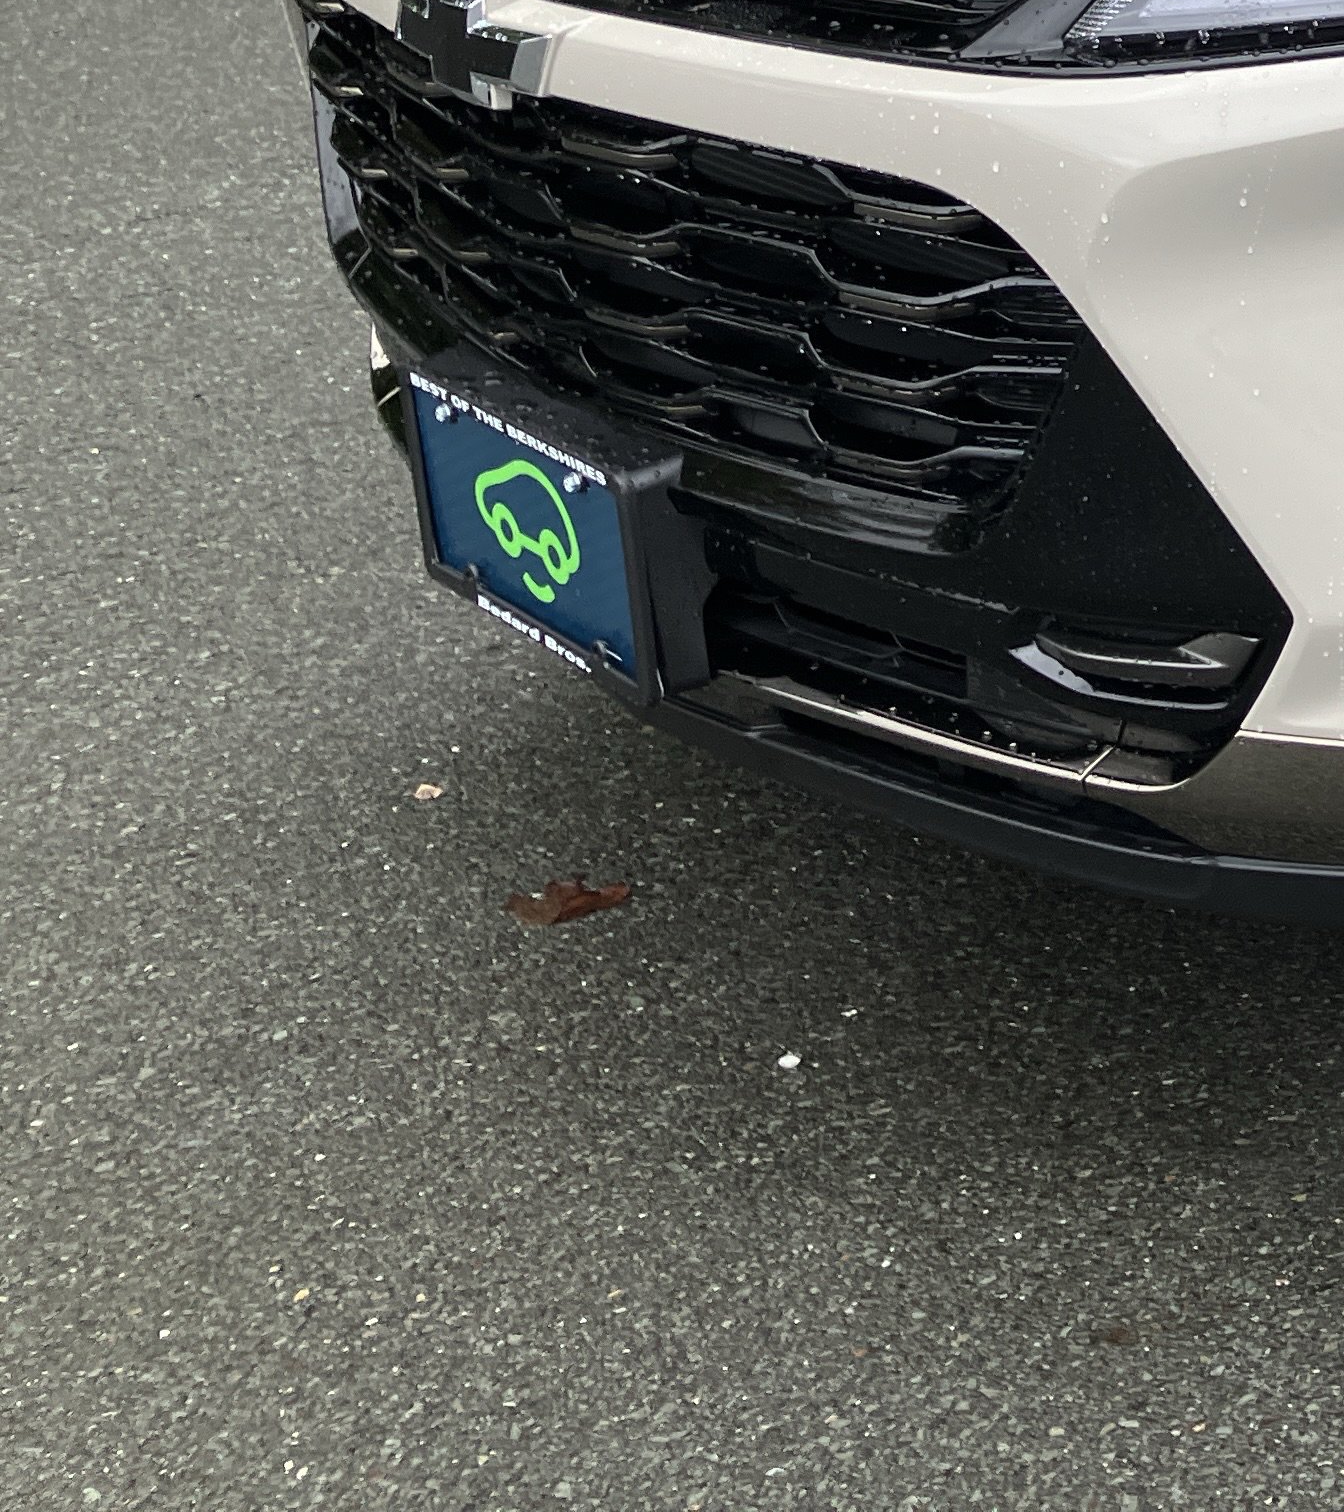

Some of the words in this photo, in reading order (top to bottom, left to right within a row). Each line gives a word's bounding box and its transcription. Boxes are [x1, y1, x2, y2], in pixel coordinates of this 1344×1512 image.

[409, 372, 448, 401] BEST
[450, 394, 470, 413] OF
[471, 405, 505, 433] THE
[505, 423, 607, 486] BERKSHIRES
[477, 594, 541, 642] Bedard
[544, 634, 592, 673] Bros.
